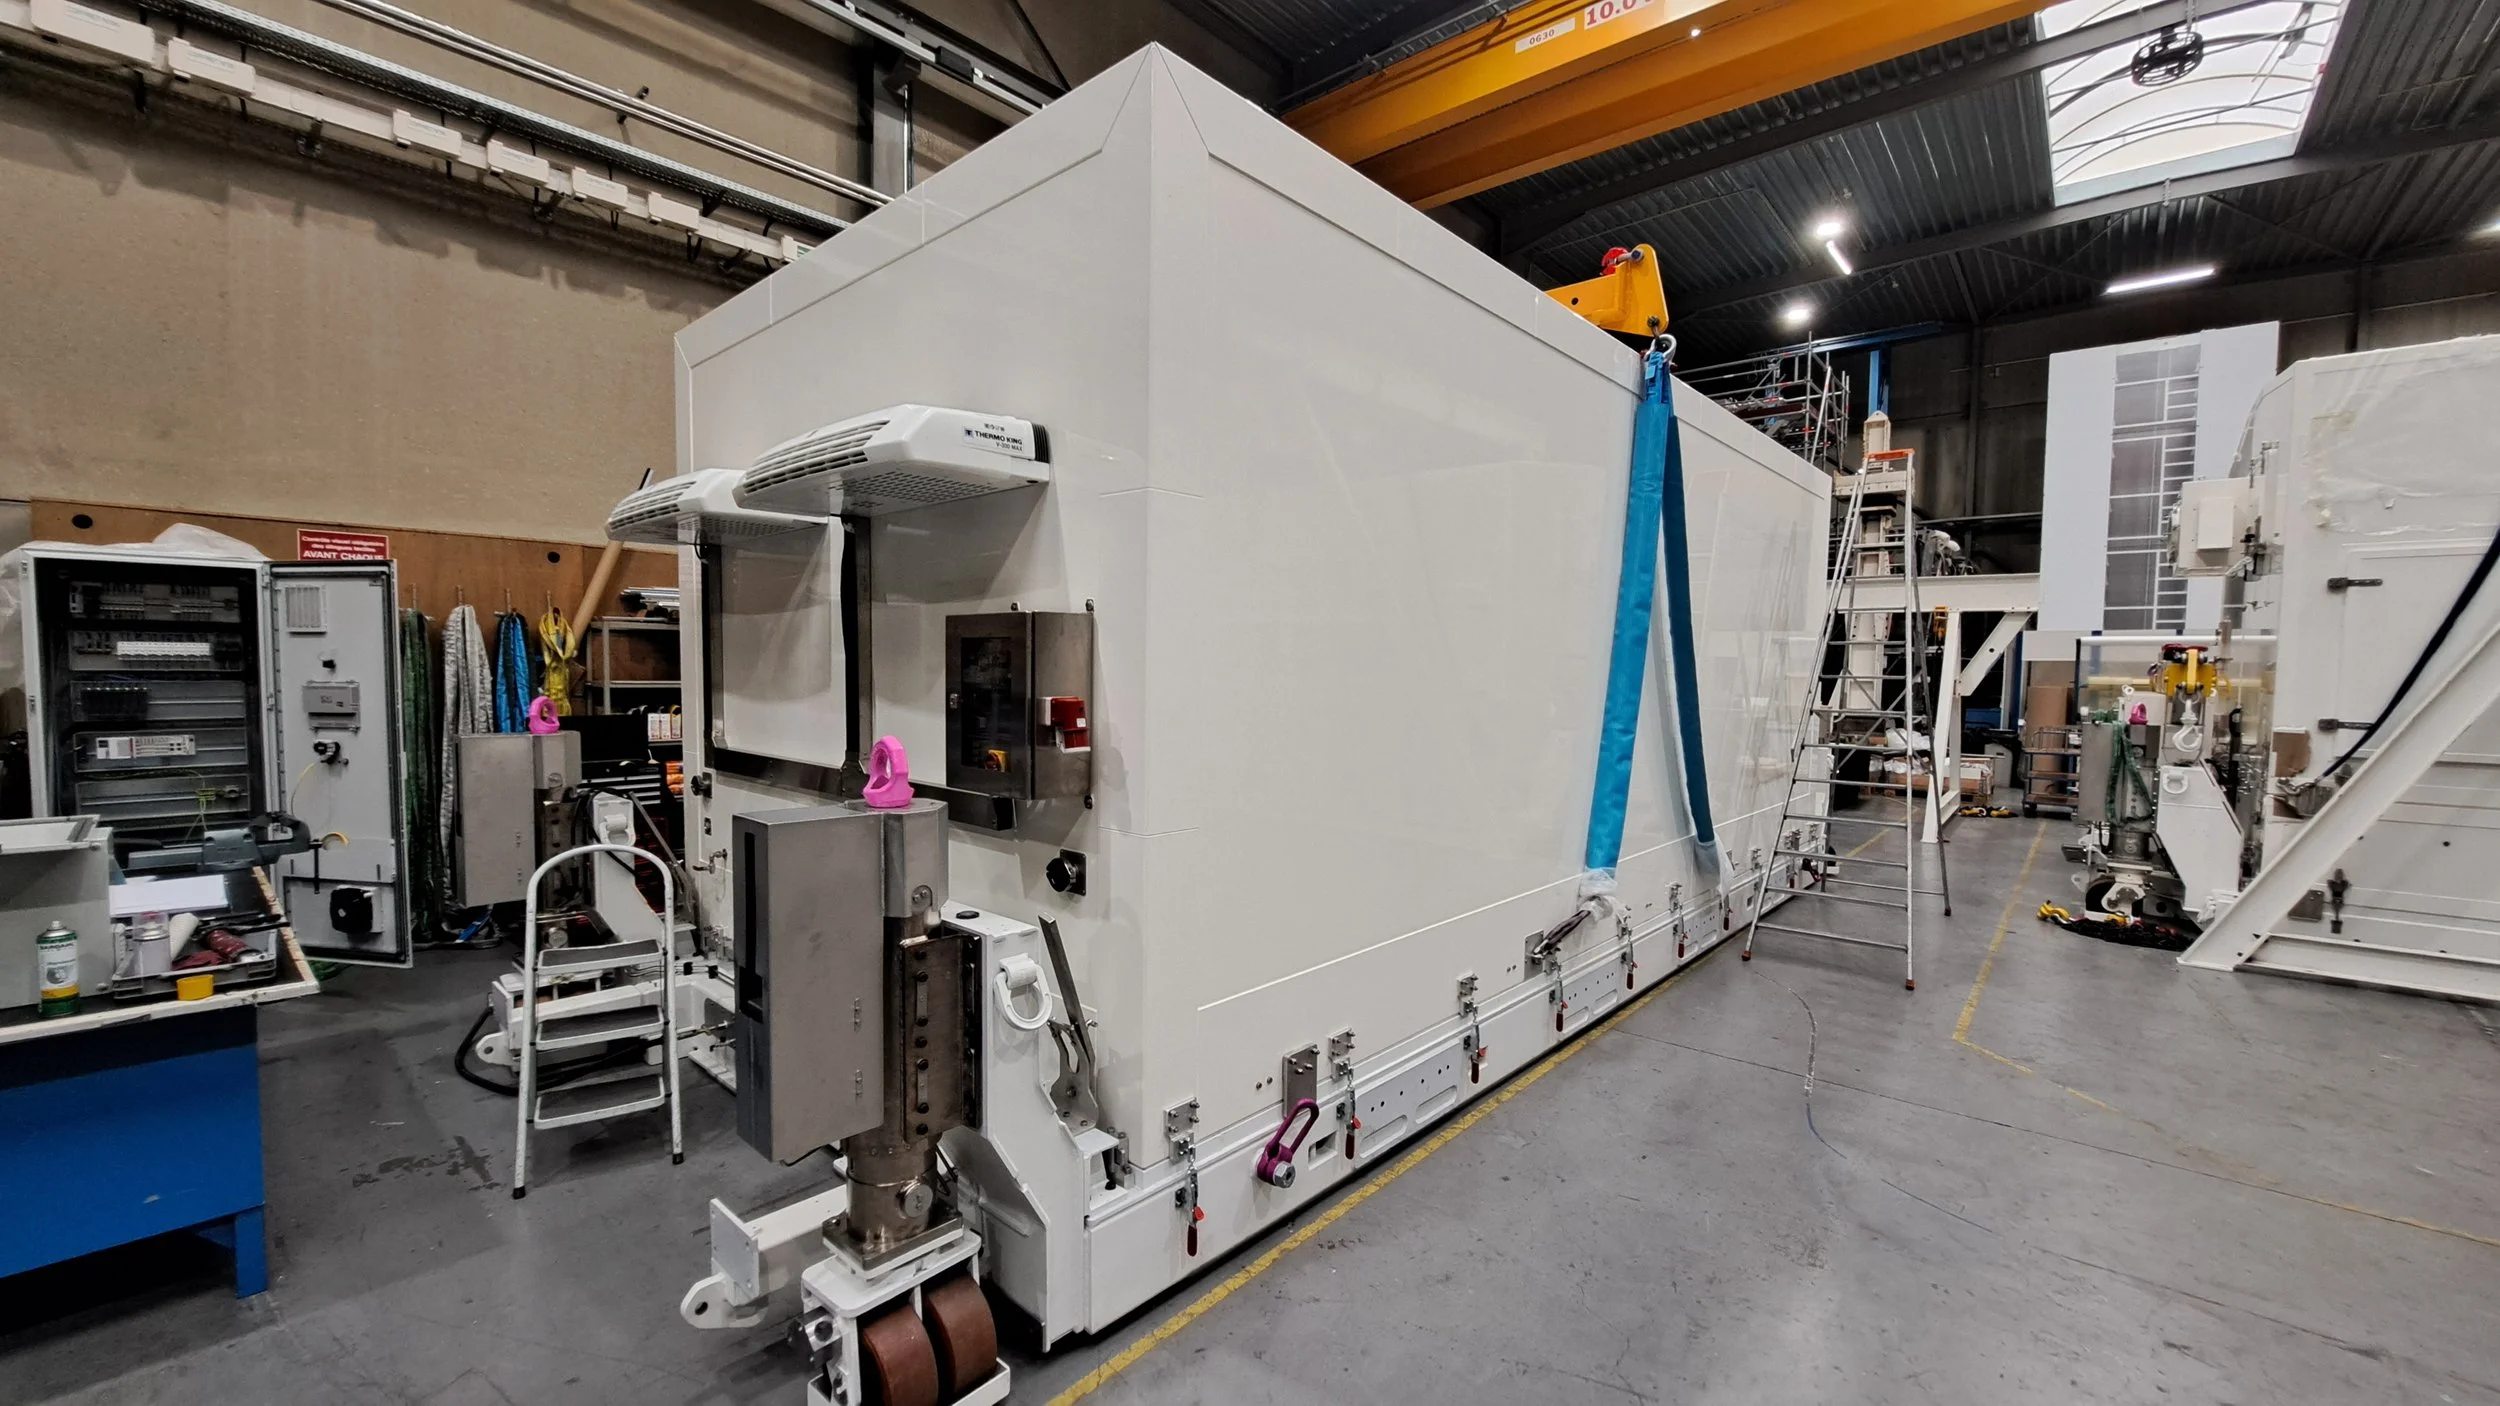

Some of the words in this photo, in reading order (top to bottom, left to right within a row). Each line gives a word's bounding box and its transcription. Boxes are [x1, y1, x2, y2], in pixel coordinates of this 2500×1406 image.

[1587, 0, 1651, 26] 10.0
[1529, 29, 1555, 46] 0630
[974, 430, 1006, 442] THERMO
[1006, 436, 1023, 446] KING
[303, 550, 338, 559] AVANT
